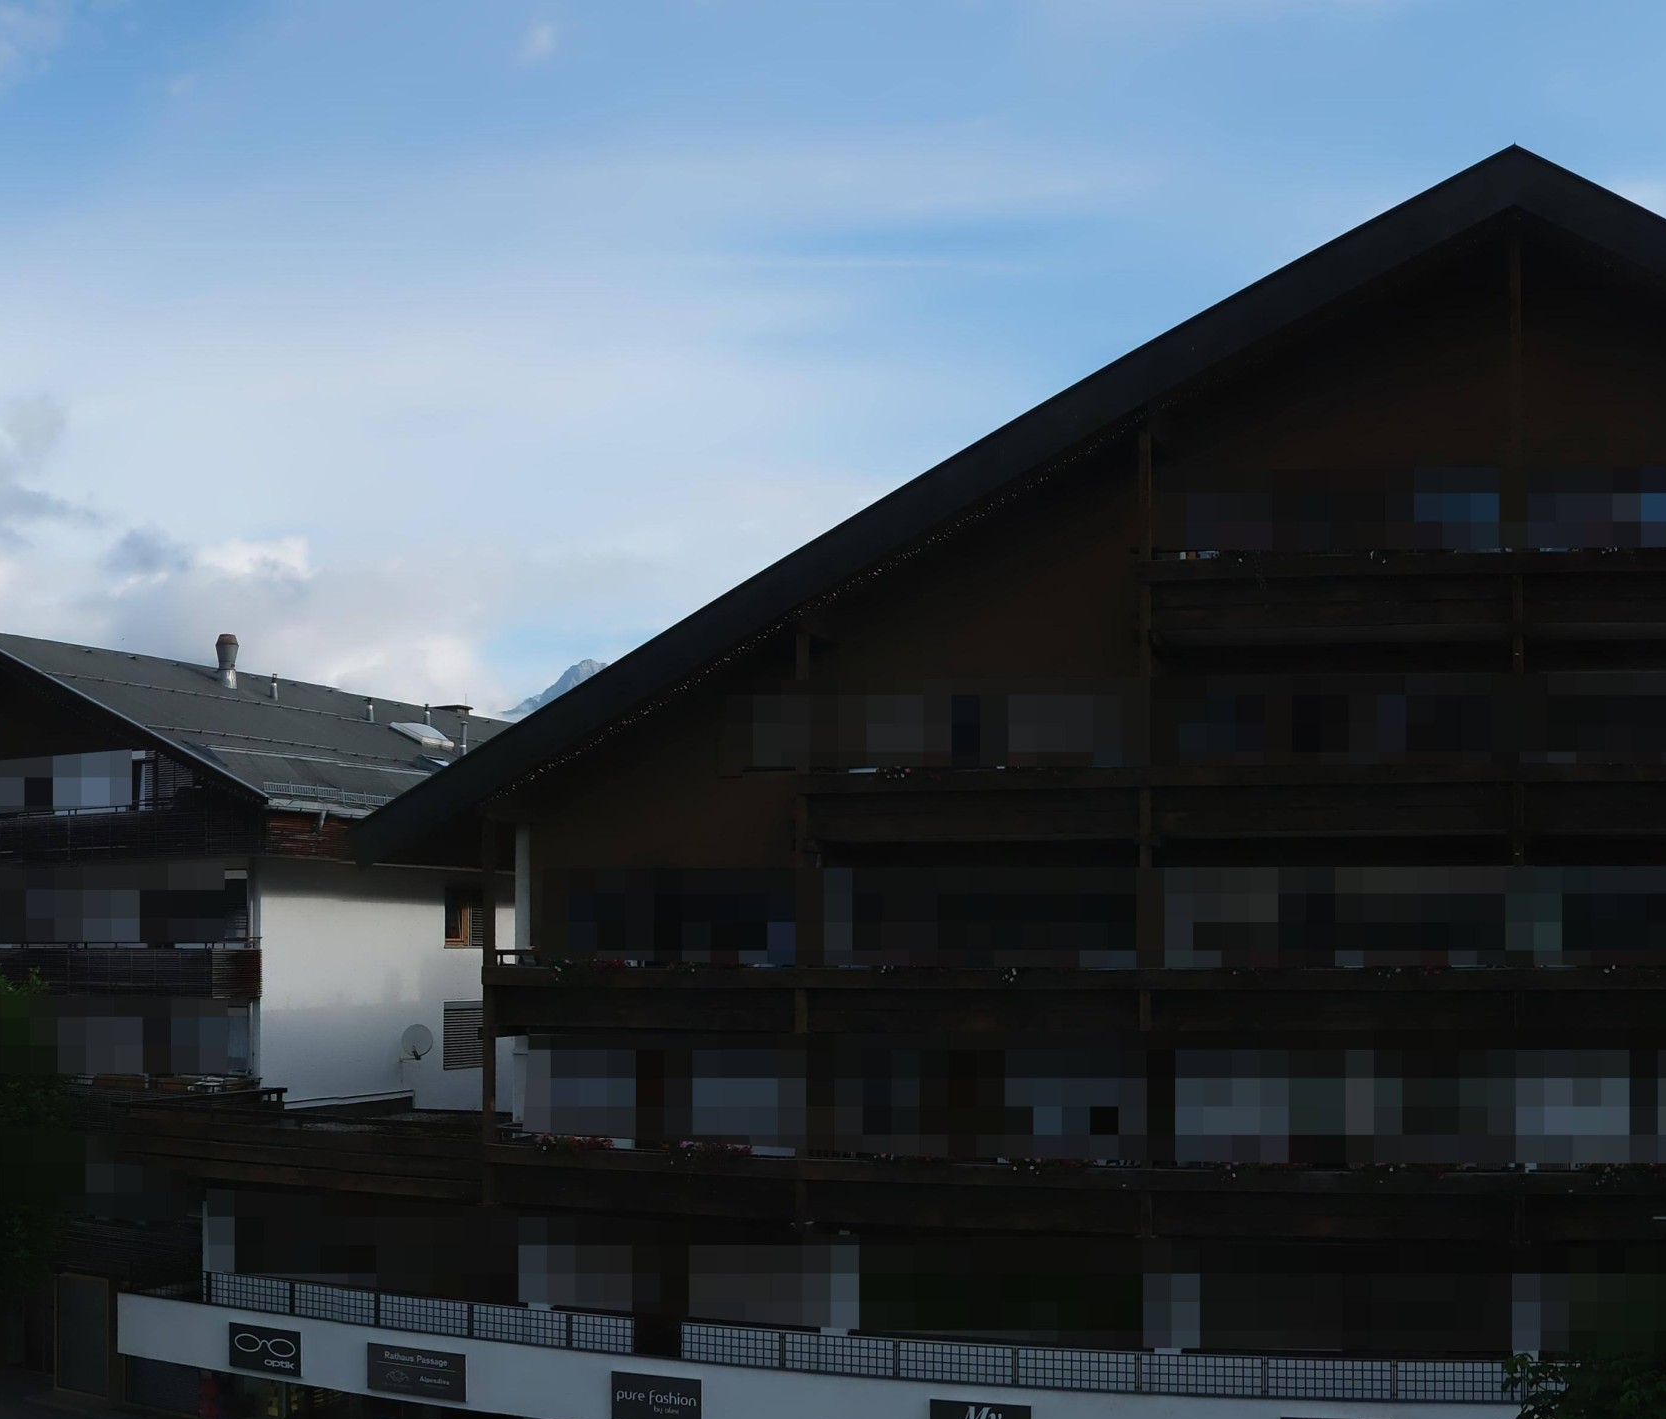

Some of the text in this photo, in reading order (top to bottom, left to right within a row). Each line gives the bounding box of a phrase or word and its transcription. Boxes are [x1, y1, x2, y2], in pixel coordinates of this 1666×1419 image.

[264, 1358, 295, 1370] optik
[384, 1351, 448, 1368] Rathaus Passage
[616, 1389, 697, 1407] pure fashion
[654, 1406, 663, 1414] by
